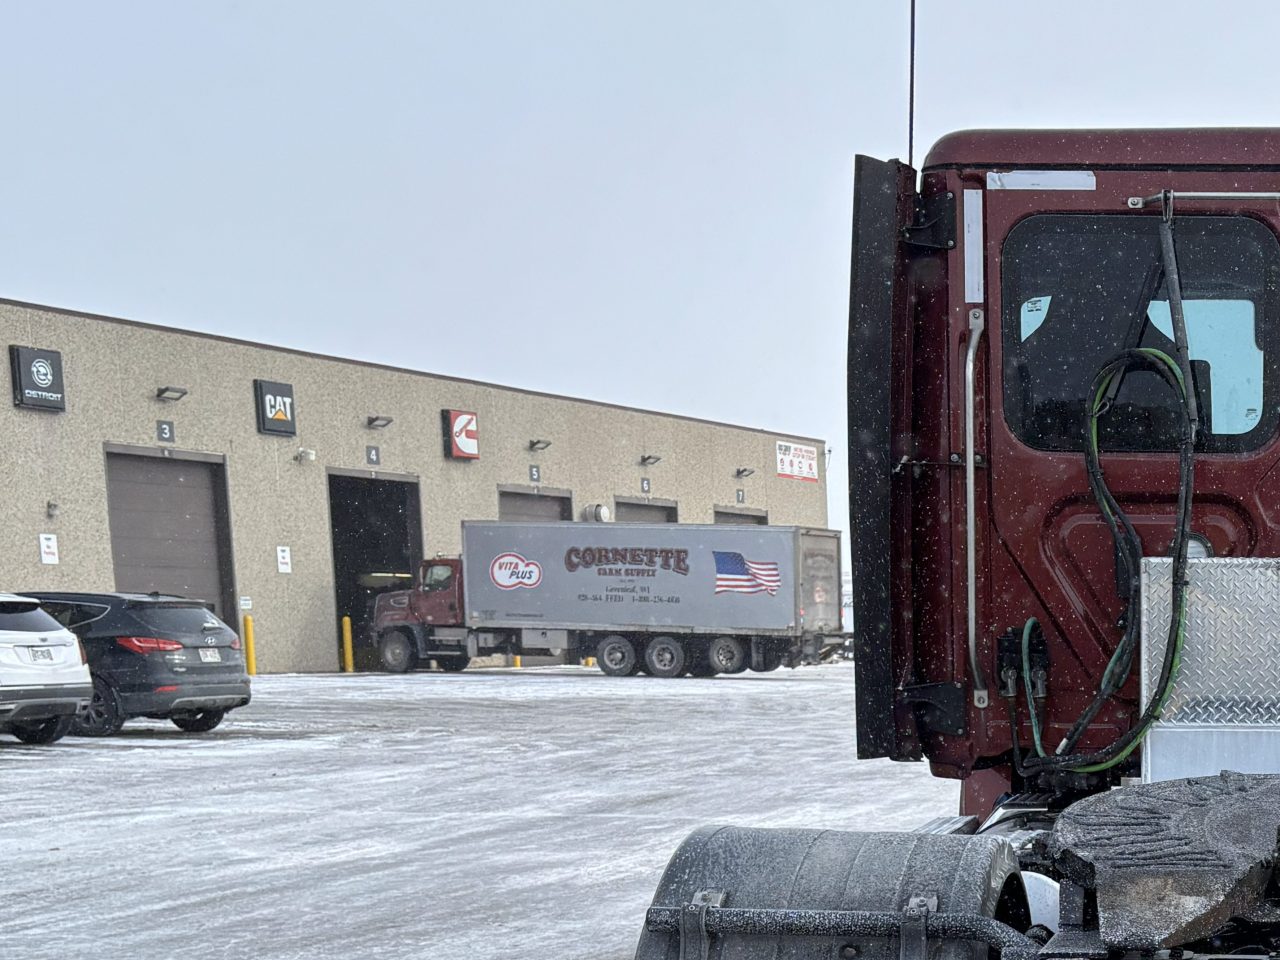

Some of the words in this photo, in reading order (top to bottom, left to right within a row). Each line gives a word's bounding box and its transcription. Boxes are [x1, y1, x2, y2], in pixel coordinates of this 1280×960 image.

[25, 389, 62, 401] DETROIT
[265, 394, 292, 421] CAT
[161, 424, 170, 438] 3
[370, 449, 377, 461] 4
[532, 467, 538, 479] 5
[643, 480, 649, 491] 6
[738, 491, 743, 501] 7
[498, 561, 520, 571] VITA
[564, 546, 690, 576] CORNETTE
[509, 570, 534, 580] PLUS
